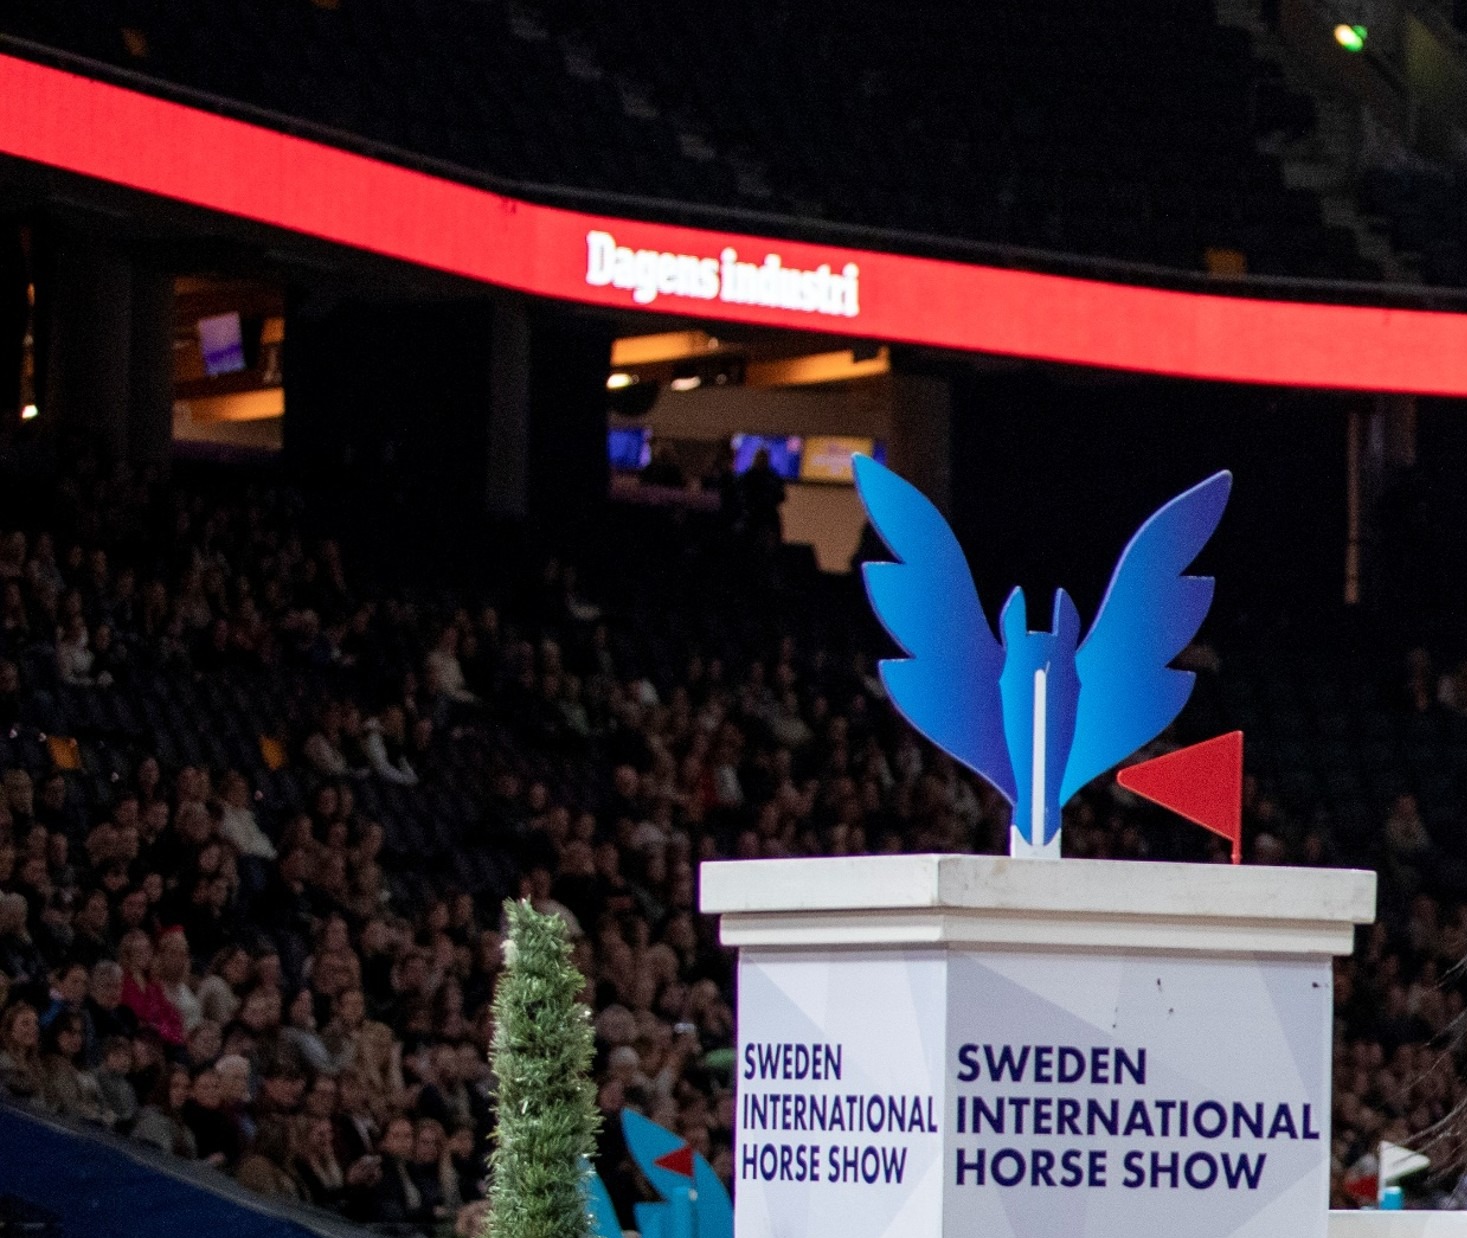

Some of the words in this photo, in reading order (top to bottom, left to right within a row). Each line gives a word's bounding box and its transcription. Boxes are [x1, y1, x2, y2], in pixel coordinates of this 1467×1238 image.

[586, 230, 720, 304] Dagens
[720, 247, 860, 317] industri
[744, 1042, 842, 1080] SWEDEN
[957, 1043, 1147, 1085] SWEDEN
[743, 1093, 938, 1133] INTERNATIONAL
[956, 1096, 1320, 1139] INTERNATIONAL
[742, 1143, 820, 1182] HORSE
[828, 1144, 907, 1184] SHOW
[956, 1148, 1107, 1187] HORSE
[1122, 1150, 1267, 1189] SHOW
